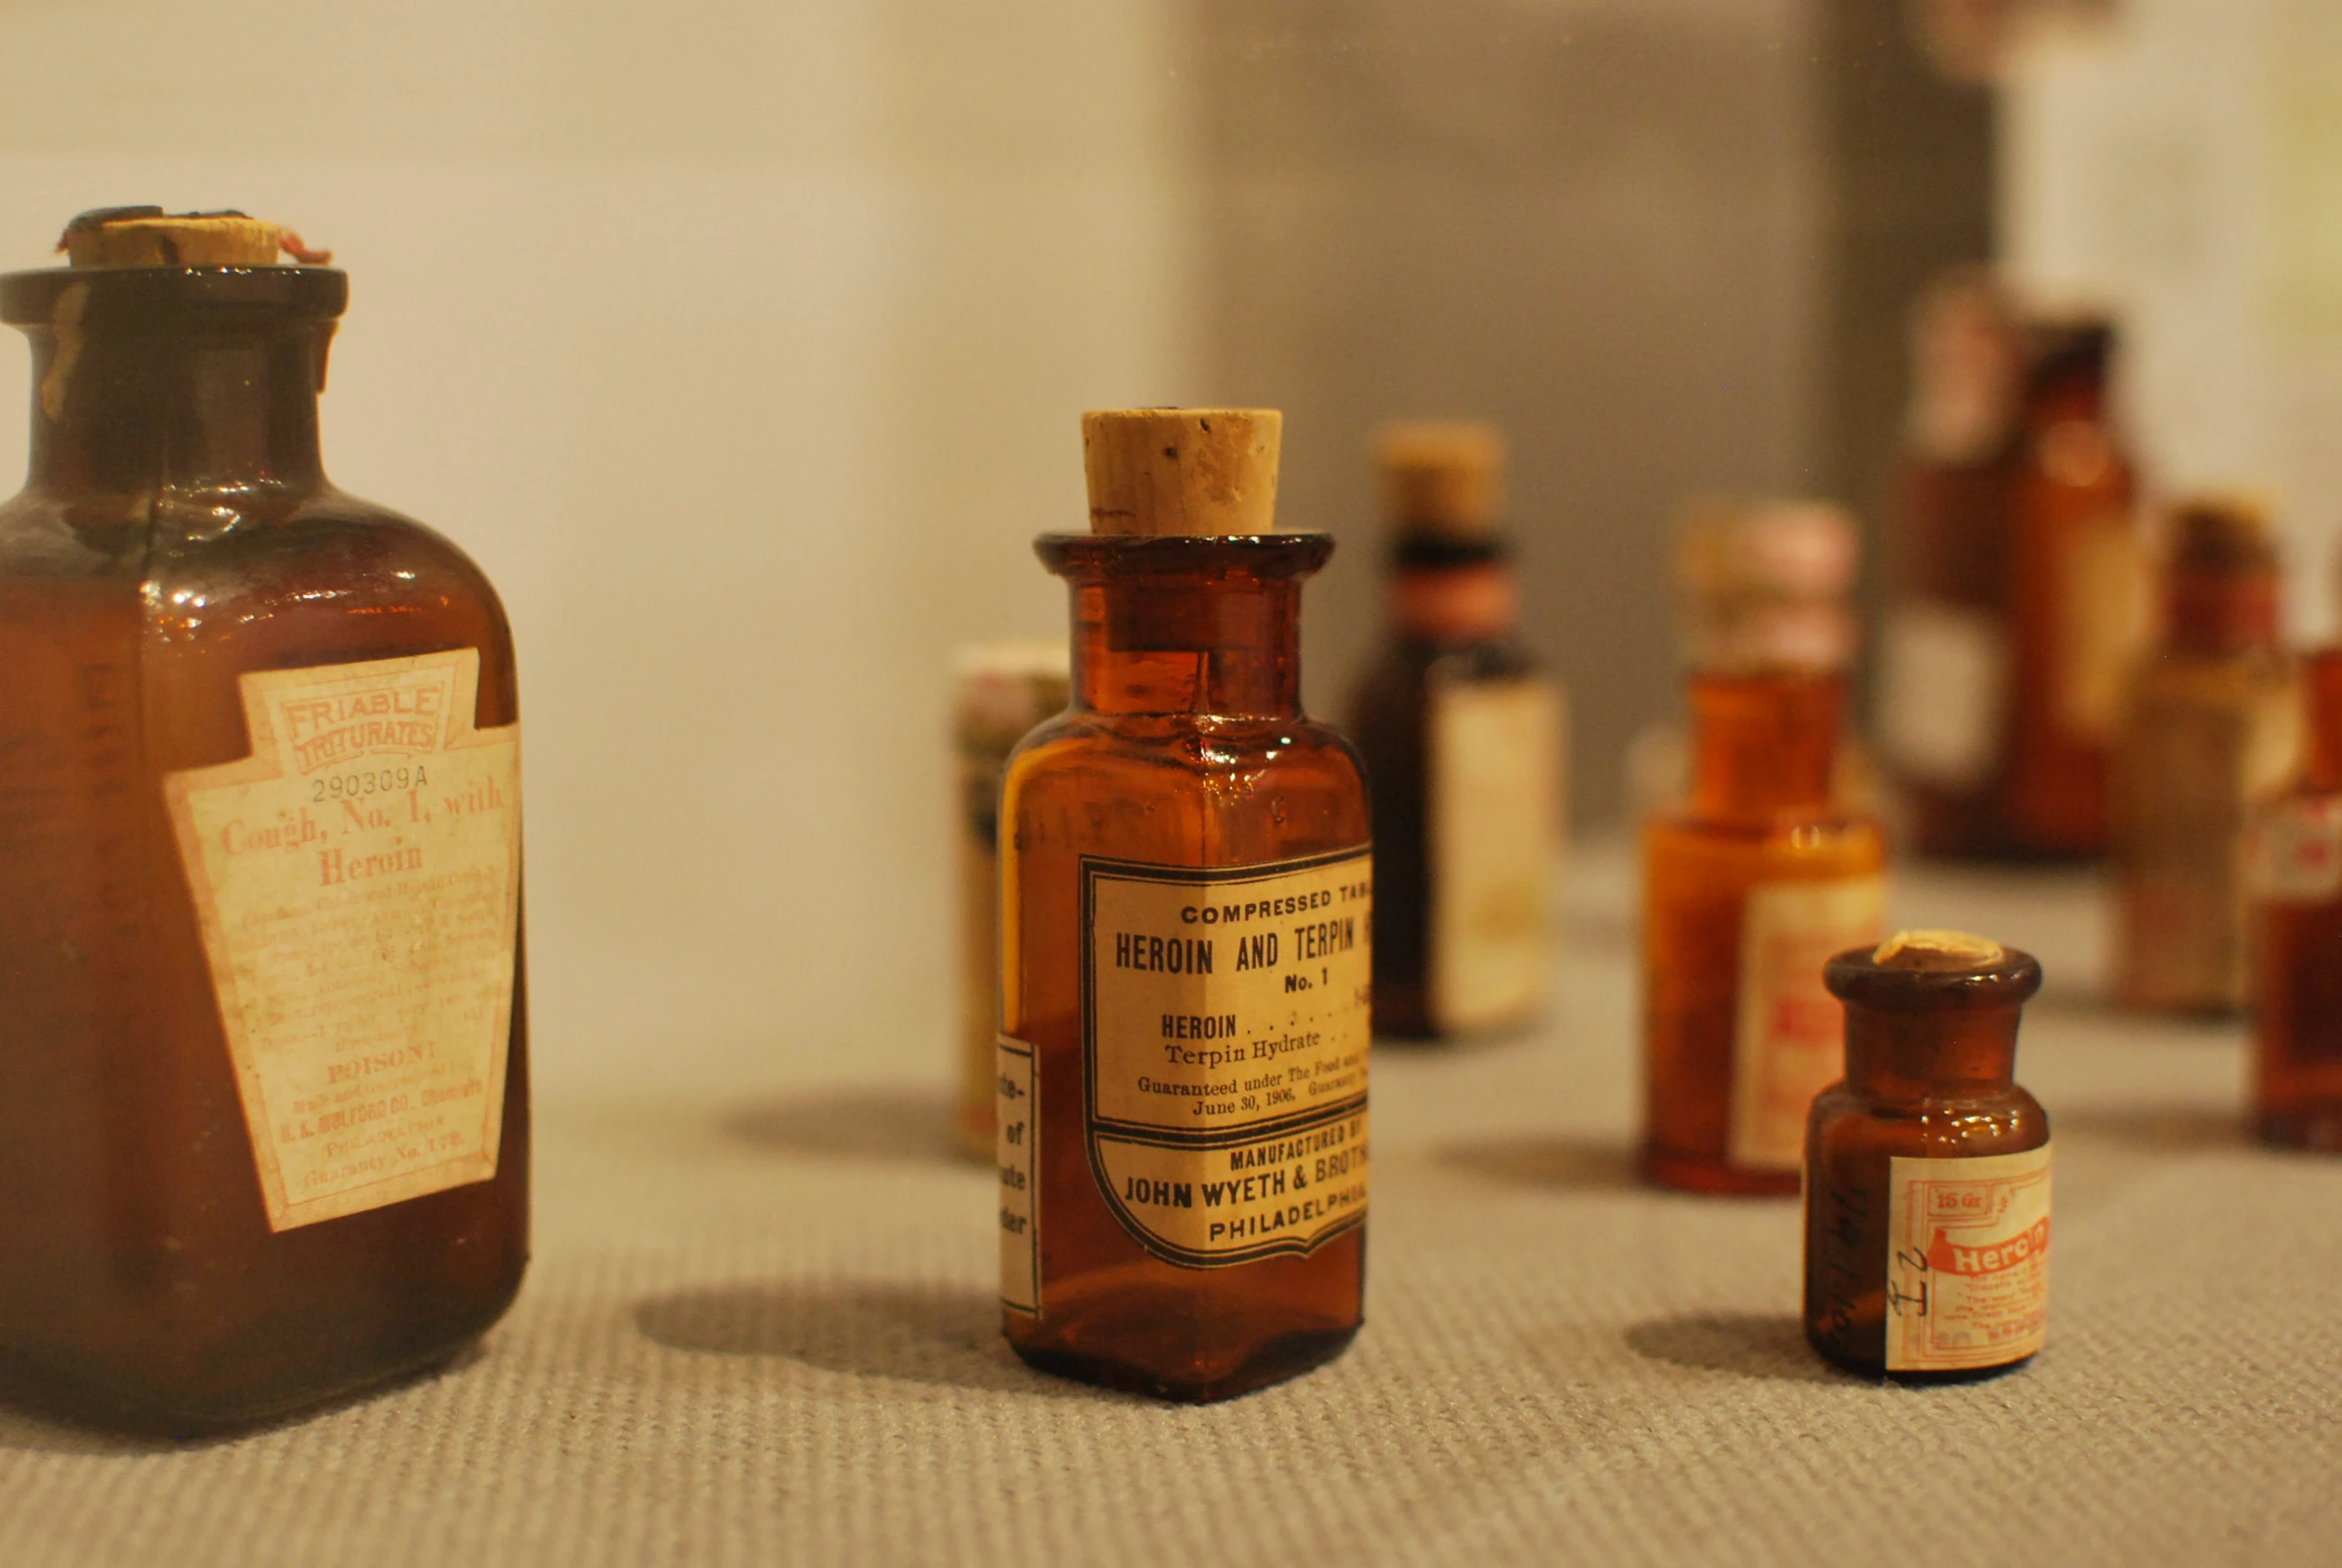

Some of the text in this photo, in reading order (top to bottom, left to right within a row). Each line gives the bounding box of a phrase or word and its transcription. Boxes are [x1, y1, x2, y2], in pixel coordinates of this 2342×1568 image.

[286, 686, 439, 739] FRIABLE
[294, 720, 434, 769] TRITURATES
[312, 765, 427, 804] 290309A
[220, 807, 328, 857] Cough,
[340, 796, 390, 835] No.
[444, 775, 504, 815] with
[319, 836, 423, 887] Heroin
[1180, 889, 1331, 925] COMPRESSED
[1116, 932, 1213, 975] HEROIN
[1235, 932, 1278, 972] AND
[1294, 916, 1354, 962] TERPIN
[1284, 966, 1329, 995] No. 1
[1162, 1014, 1236, 1041] HEROIN
[1164, 1030, 1321, 1069] Terpin Hydrate
[1138, 1077, 1237, 1097] Guaranteed
[1244, 1073, 1282, 1092] under
[1288, 1066, 1310, 1083] The
[1192, 1101, 1236, 1116] June
[1240, 1096, 1260, 1112] 30,
[1007, 1121, 1026, 1147] of
[1229, 1125, 1344, 1172] MANUFACTURED
[1125, 1176, 1192, 1208] JOHN
[1201, 1169, 1285, 1208] WYETH
[1293, 1165, 1307, 1189] &
